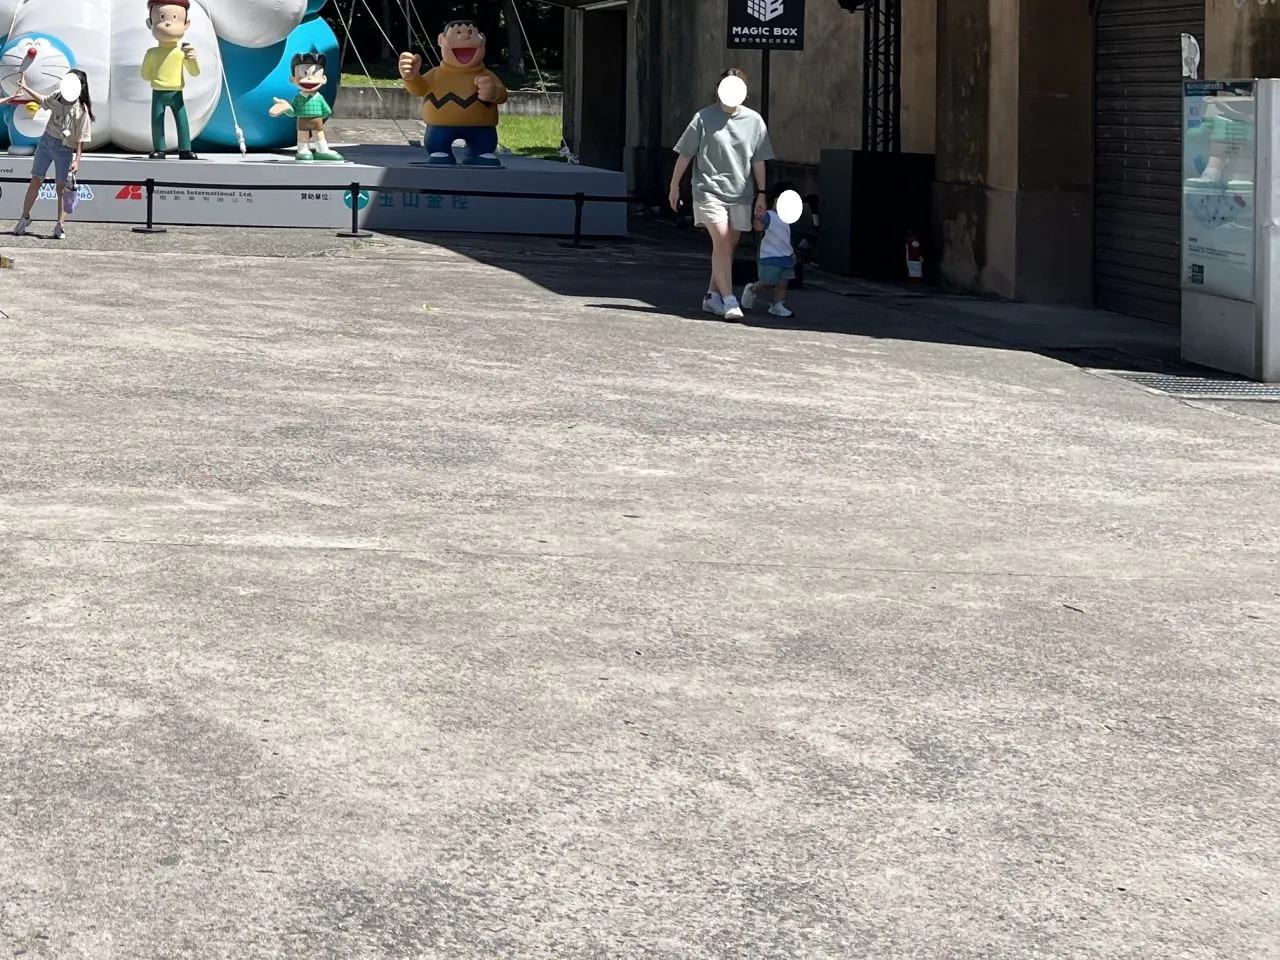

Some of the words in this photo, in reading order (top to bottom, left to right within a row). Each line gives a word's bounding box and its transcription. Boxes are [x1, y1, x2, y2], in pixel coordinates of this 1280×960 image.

[773, 27, 798, 36] BOX
[186, 189, 236, 197] International
[378, 191, 470, 210] 玉山金控
